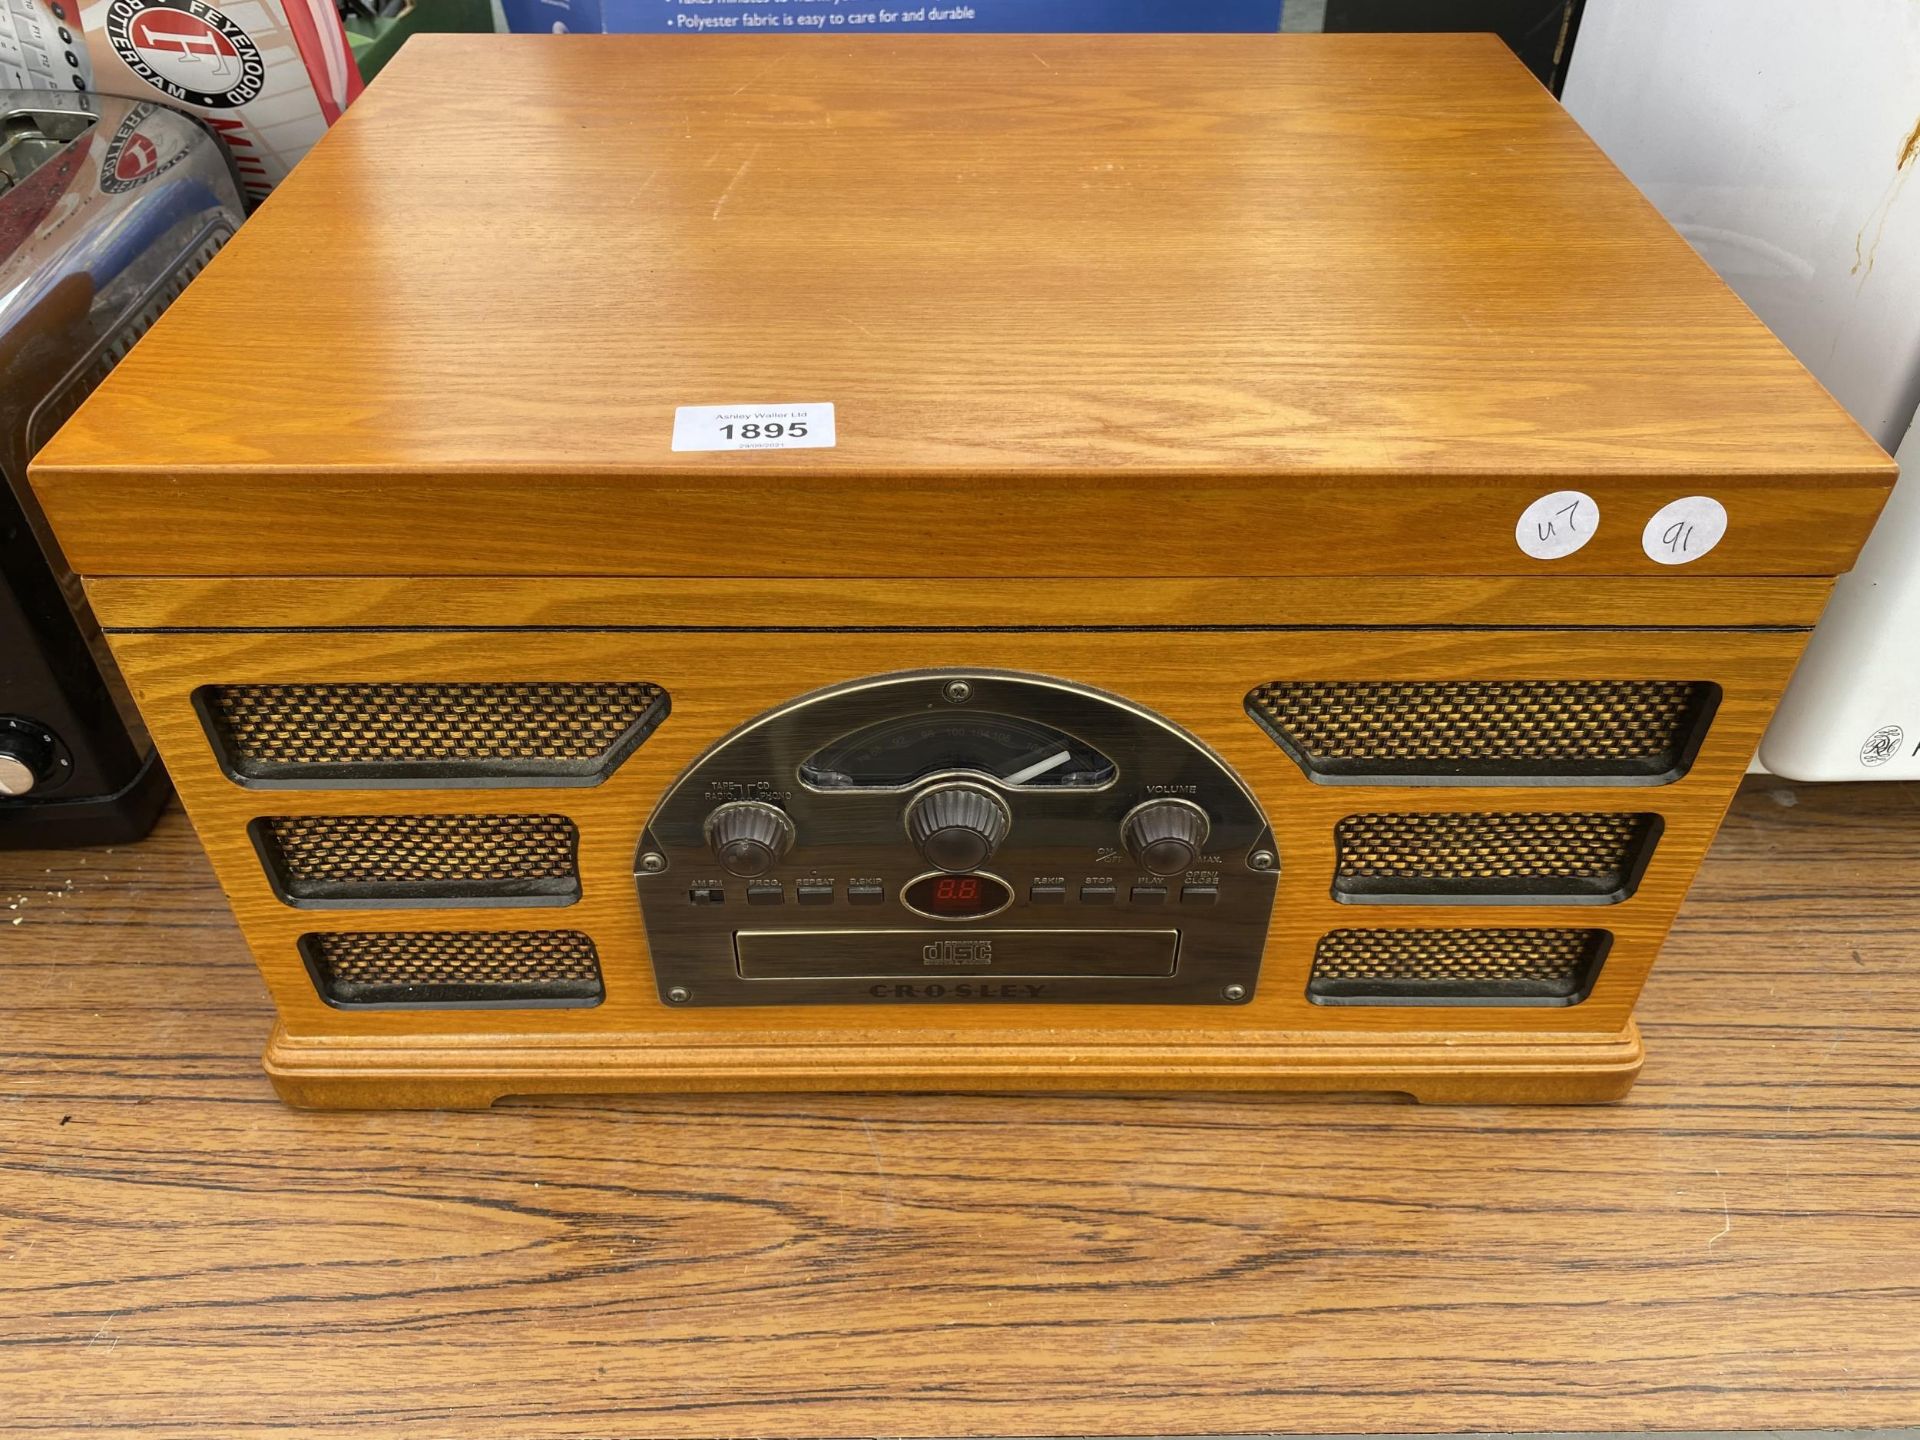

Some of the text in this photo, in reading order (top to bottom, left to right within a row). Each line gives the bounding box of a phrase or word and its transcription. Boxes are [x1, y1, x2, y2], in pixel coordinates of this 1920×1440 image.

[676, 6, 976, 31] Polyester fabric is easy to care for and durable
[189, 1, 263, 106] FEYENOORD
[715, 413, 752, 421] Ashley
[790, 410, 808, 418] Ltd
[719, 422, 809, 440] 1895
[711, 781, 735, 790] TAPE
[756, 781, 770, 790] CD
[1146, 784, 1197, 794] VOLUME
[704, 792, 733, 801] RADIO
[761, 791, 792, 800] PHONO
[748, 878, 783, 887] PROG.
[795, 878, 835, 887] REPEAT
[1085, 876, 1113, 885] STOP
[1137, 876, 1165, 885] PLAY
[1184, 877, 1220, 885] CLOSE
[868, 983, 1047, 998] CROSLEY
